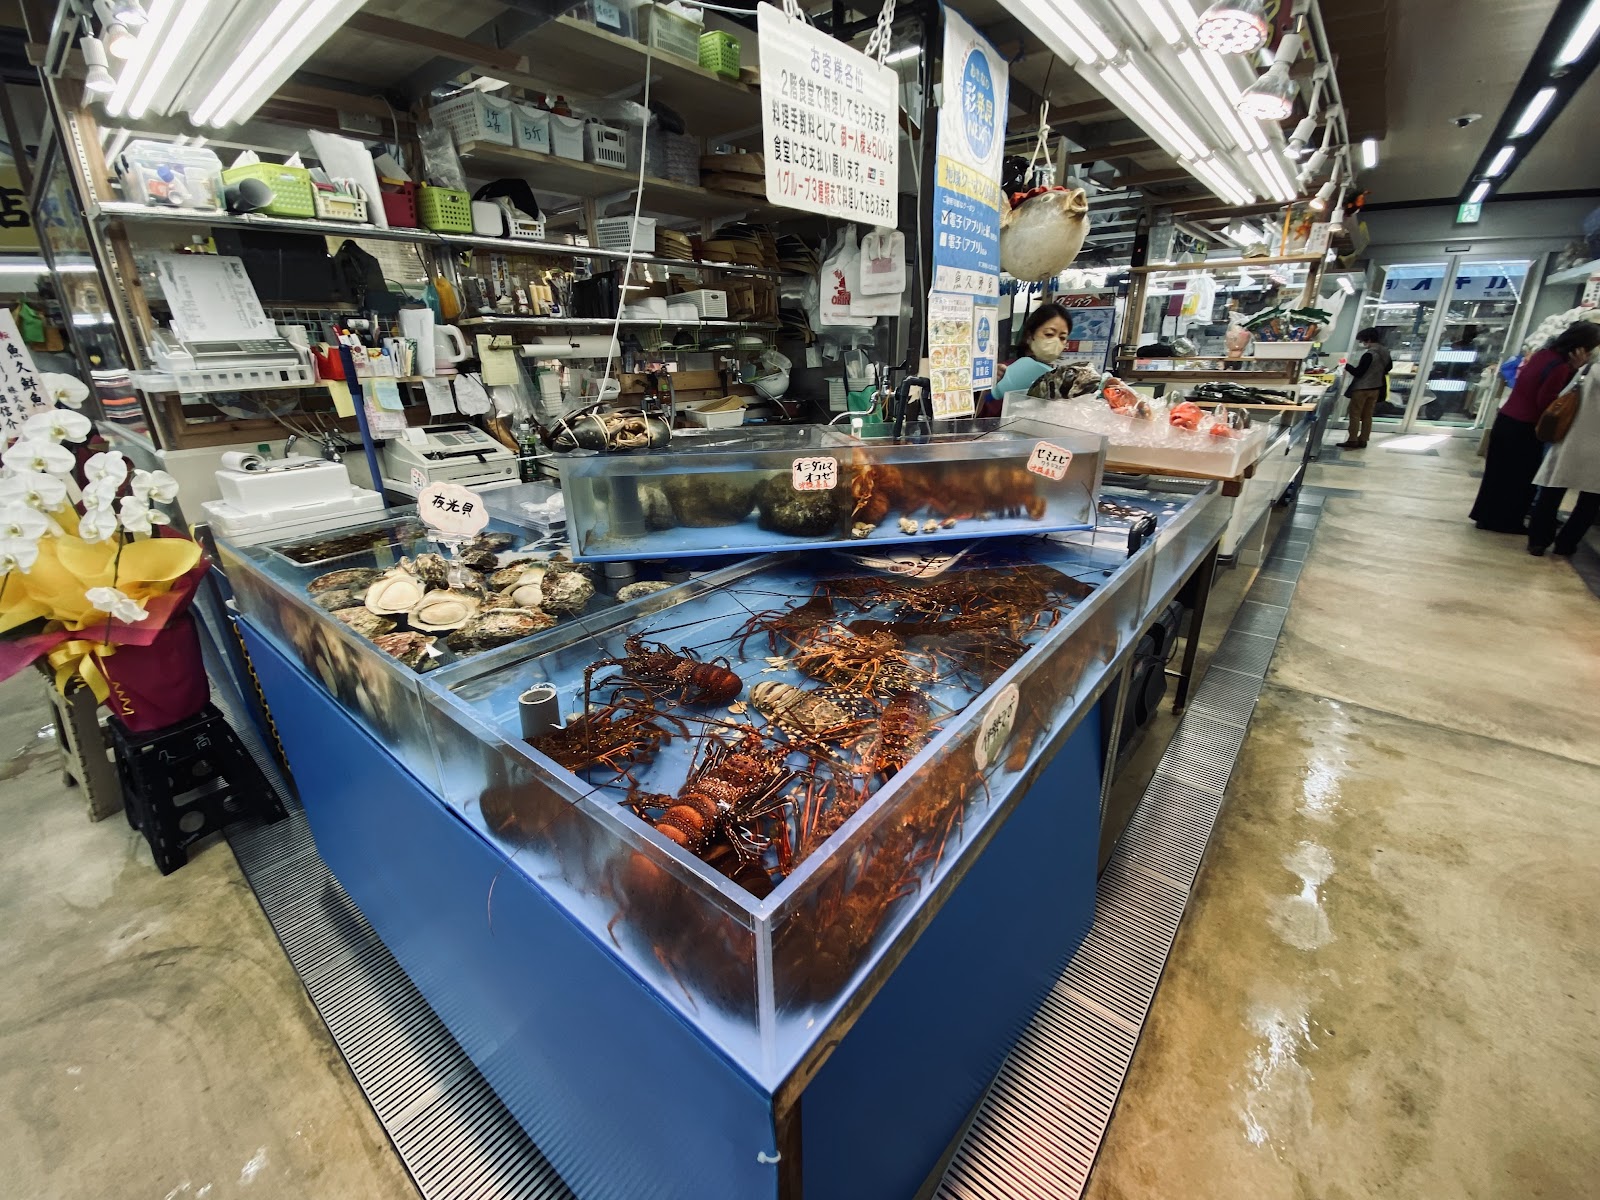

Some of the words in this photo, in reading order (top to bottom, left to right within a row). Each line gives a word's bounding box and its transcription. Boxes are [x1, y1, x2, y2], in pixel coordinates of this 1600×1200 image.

[810, 45, 863, 94] お客様各位
[781, 68, 890, 137] 2階食堂で料理してもらえます。
[773, 134, 864, 184] 食堂にお支払い願います。
[6, 342, 46, 408] 魚久鮮魚
[804, 471, 834, 483] オコゼ
[431, 491, 474, 518] 夜光貝
